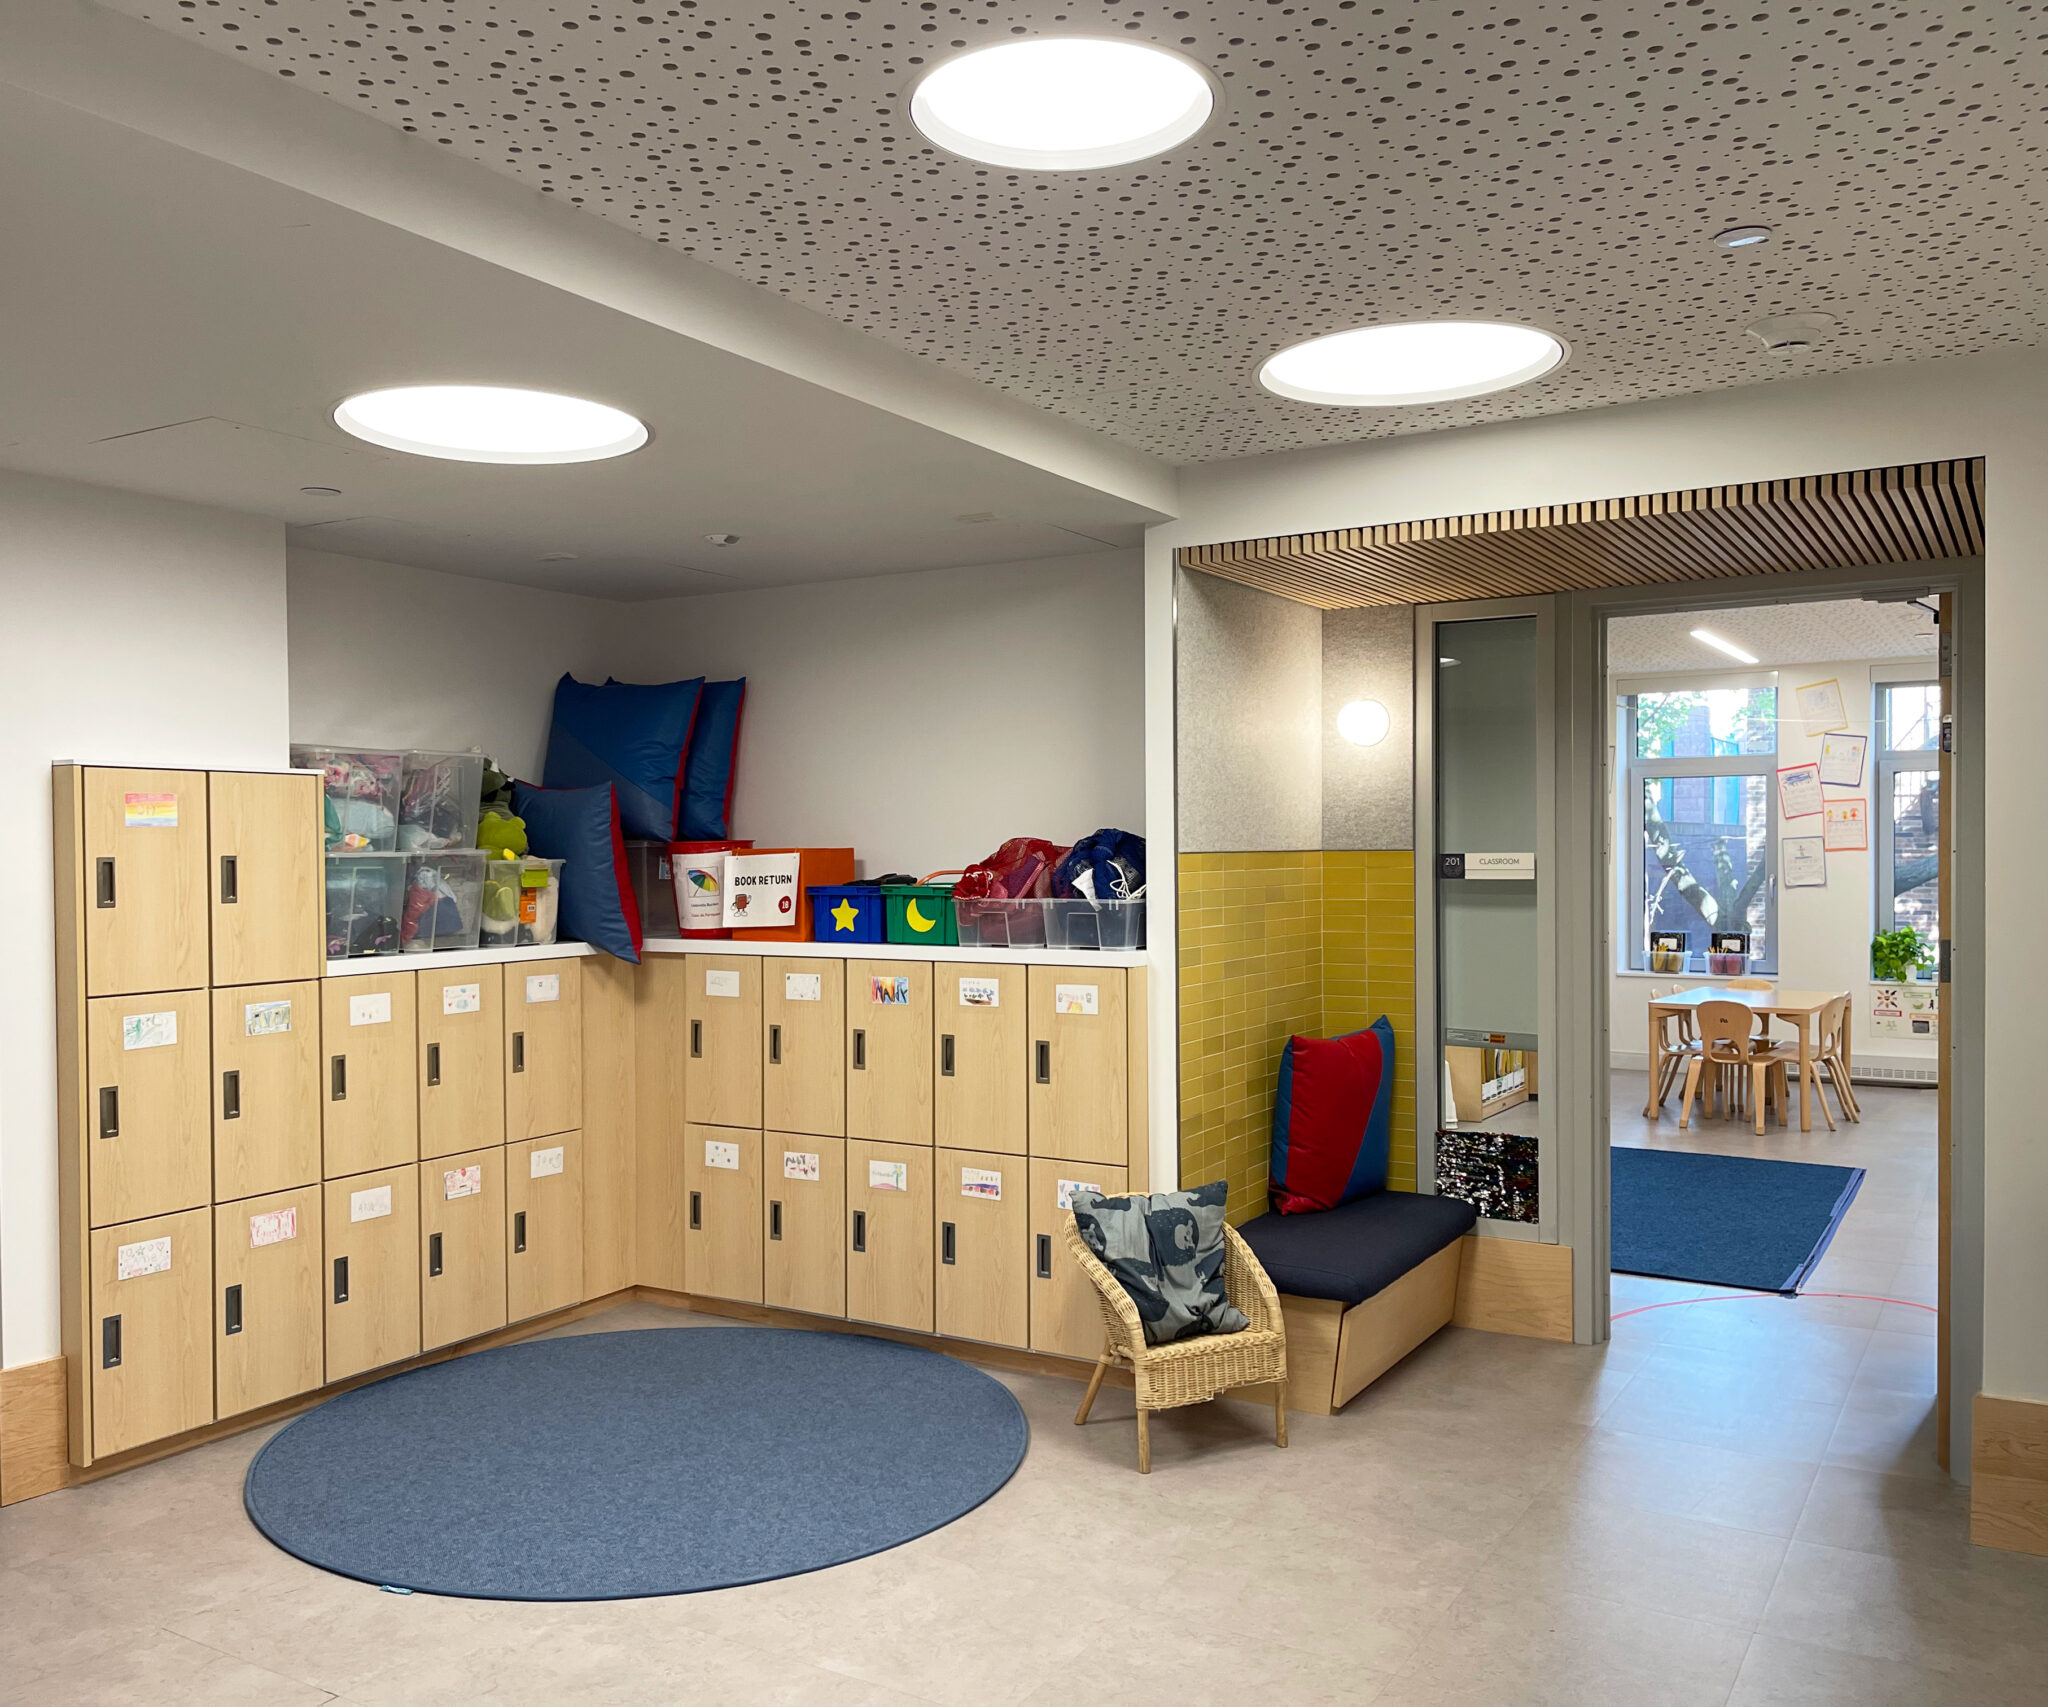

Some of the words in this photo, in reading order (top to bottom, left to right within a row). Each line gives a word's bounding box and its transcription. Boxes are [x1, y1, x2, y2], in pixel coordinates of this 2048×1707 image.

[1445, 857, 1460, 866] 201
[734, 876, 757, 887] BOOK
[758, 874, 792, 885] RETURN
